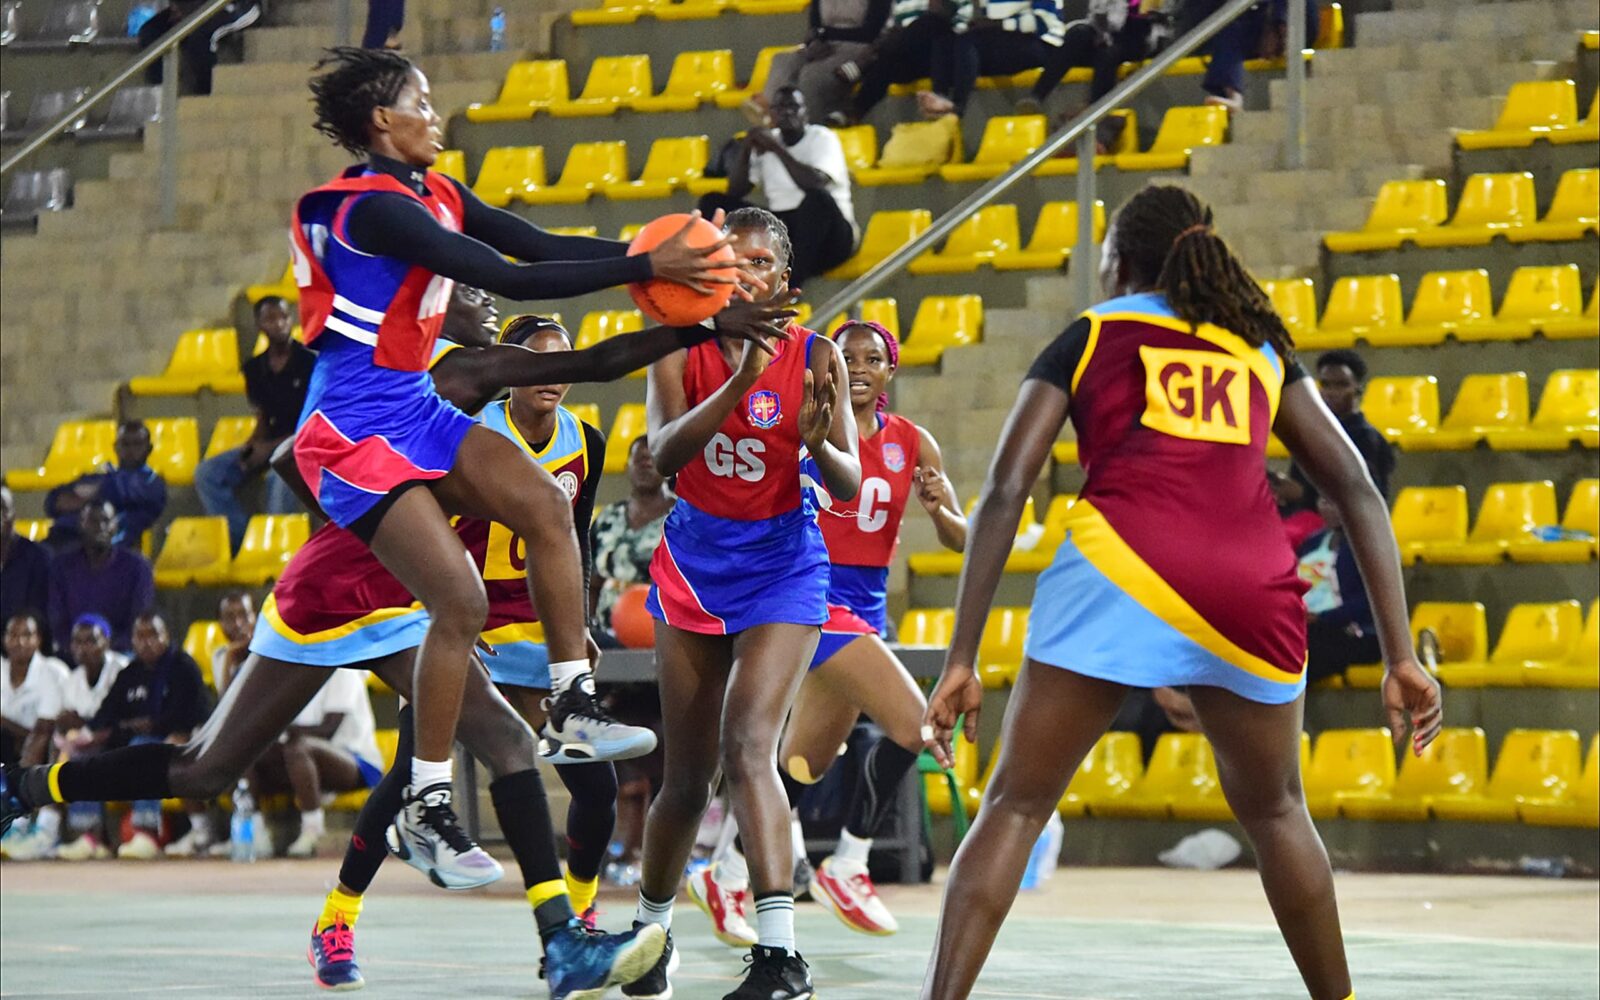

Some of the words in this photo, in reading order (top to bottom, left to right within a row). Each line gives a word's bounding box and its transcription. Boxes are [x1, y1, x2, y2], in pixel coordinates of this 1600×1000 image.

[1159, 362, 1238, 428] GK
[703, 432, 766, 482] GS
[857, 476, 891, 533] C
